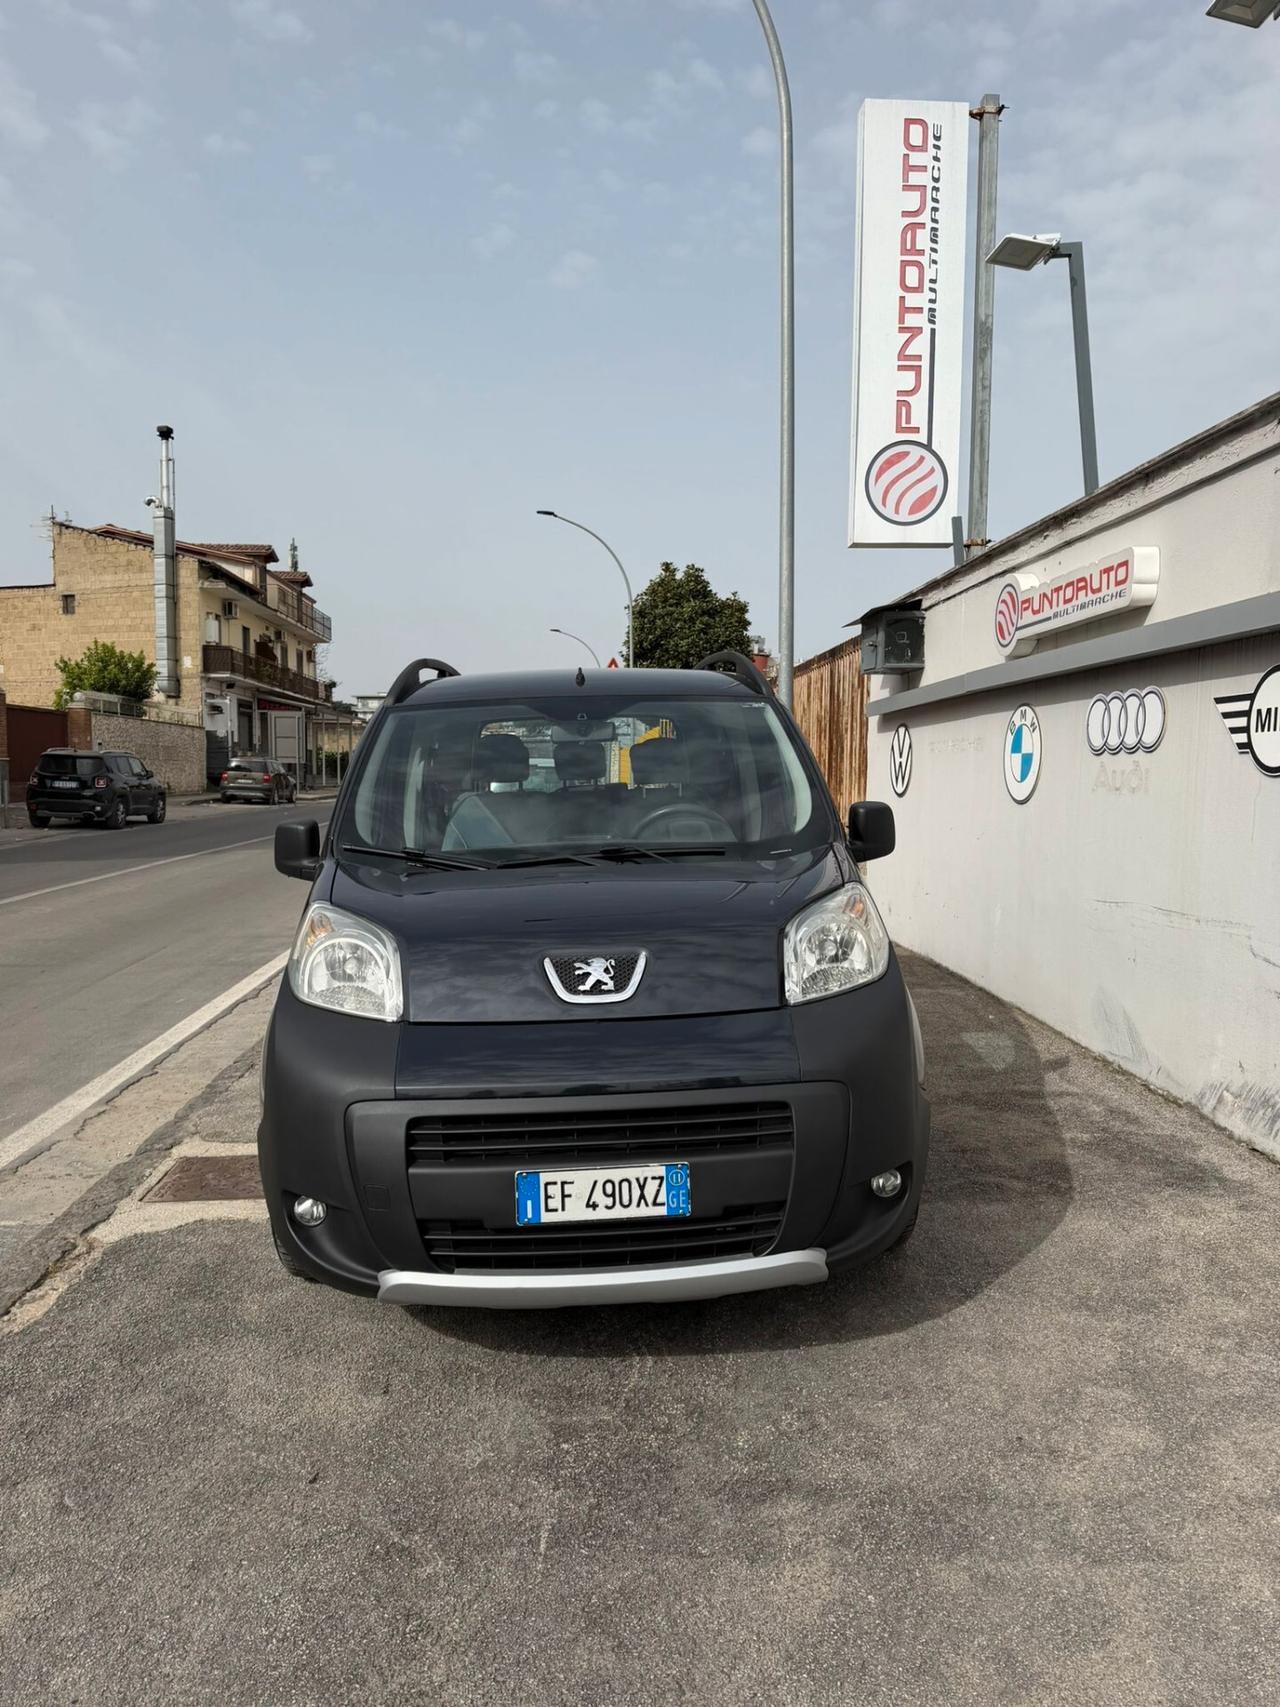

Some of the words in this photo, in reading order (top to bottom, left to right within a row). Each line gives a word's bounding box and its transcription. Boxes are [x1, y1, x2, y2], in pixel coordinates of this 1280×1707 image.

[927, 122, 943, 325] MULTIMARCHE
[895, 117, 929, 434] PUNTOAUTO
[1020, 559, 1129, 620] PUNTOAUTO
[1052, 588, 1127, 619] MULTIMARCHE
[1010, 708, 1037, 736] BMW
[1255, 706, 1280, 733] MI
[526, 1199, 533, 1219] I
[543, 1180, 574, 1212] EF
[585, 1176, 665, 1211] 490XZ
[668, 1189, 686, 1208] GE
